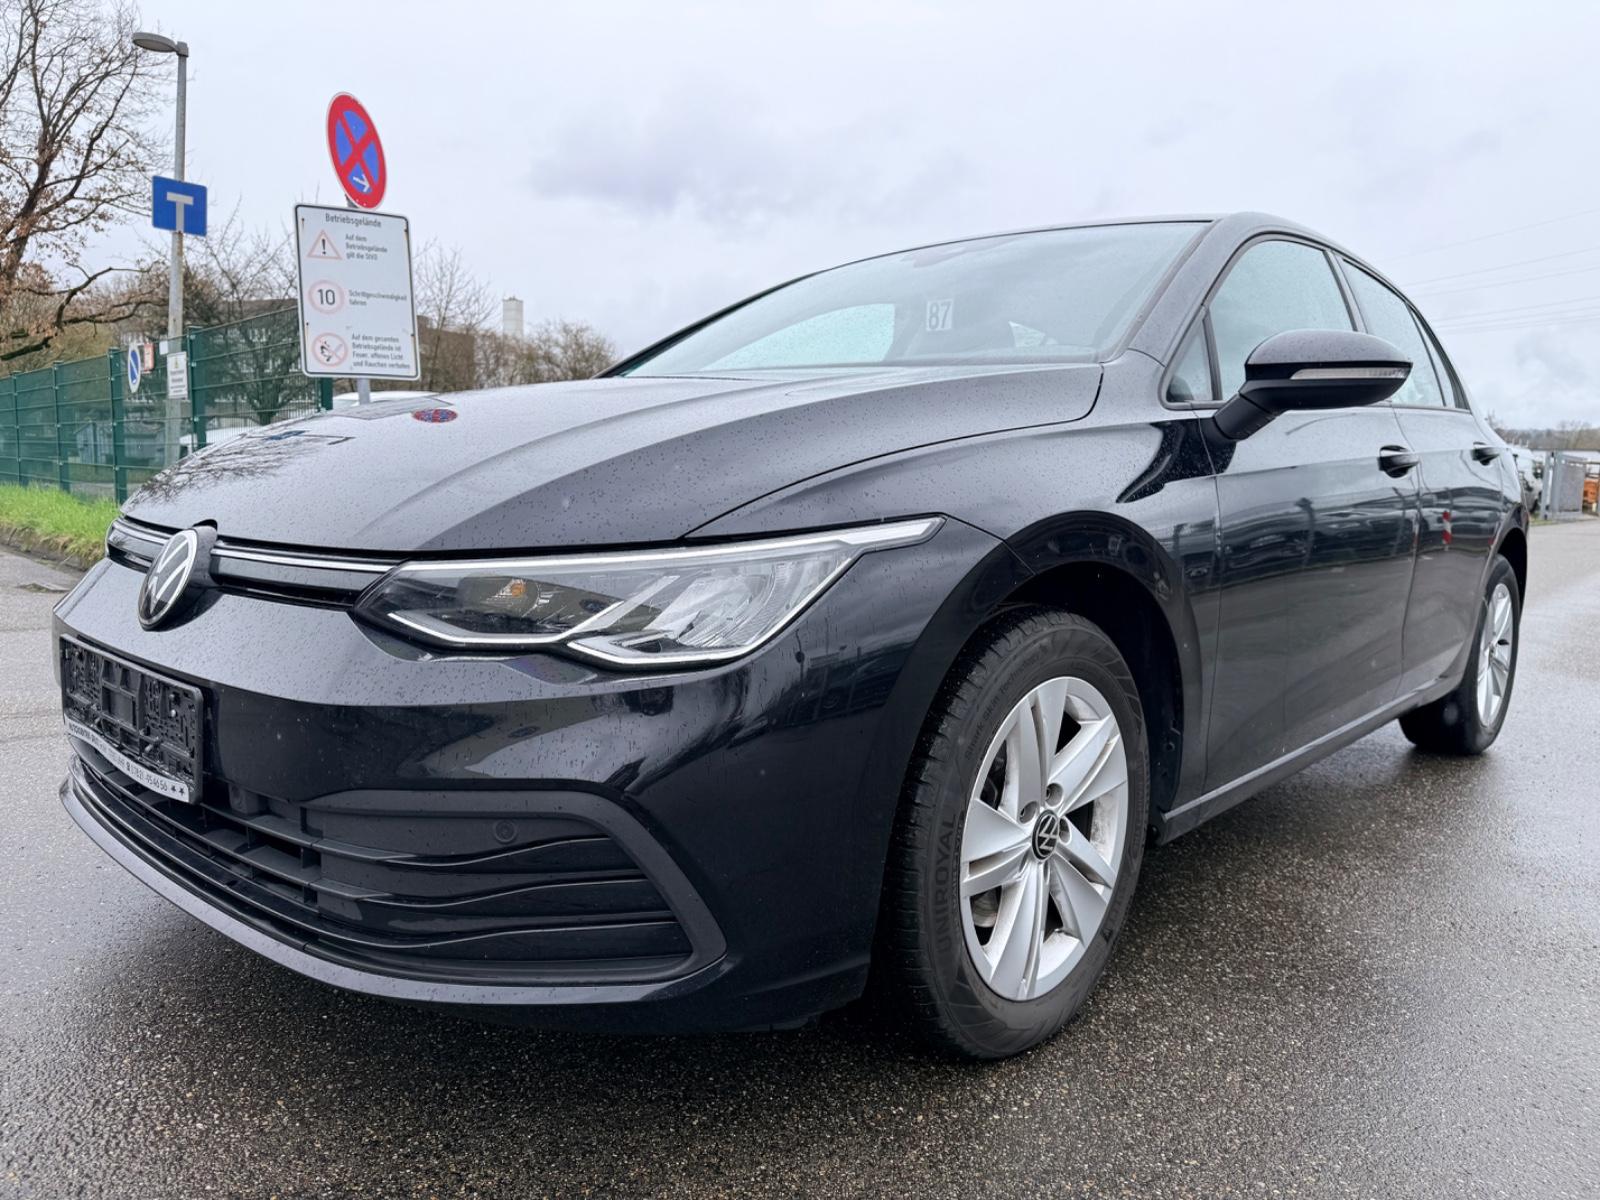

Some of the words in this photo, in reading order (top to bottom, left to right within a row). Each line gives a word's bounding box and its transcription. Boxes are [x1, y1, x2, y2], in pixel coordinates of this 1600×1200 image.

[325, 213, 382, 228] Betriebsgelände
[345, 233, 355, 241] Auf
[346, 242, 388, 253] Betriebsgelände
[317, 288, 336, 306] 10
[929, 301, 951, 330] 87
[352, 342, 395, 352] Betriebsgelände
[935, 813, 956, 954] UNIROYAL
